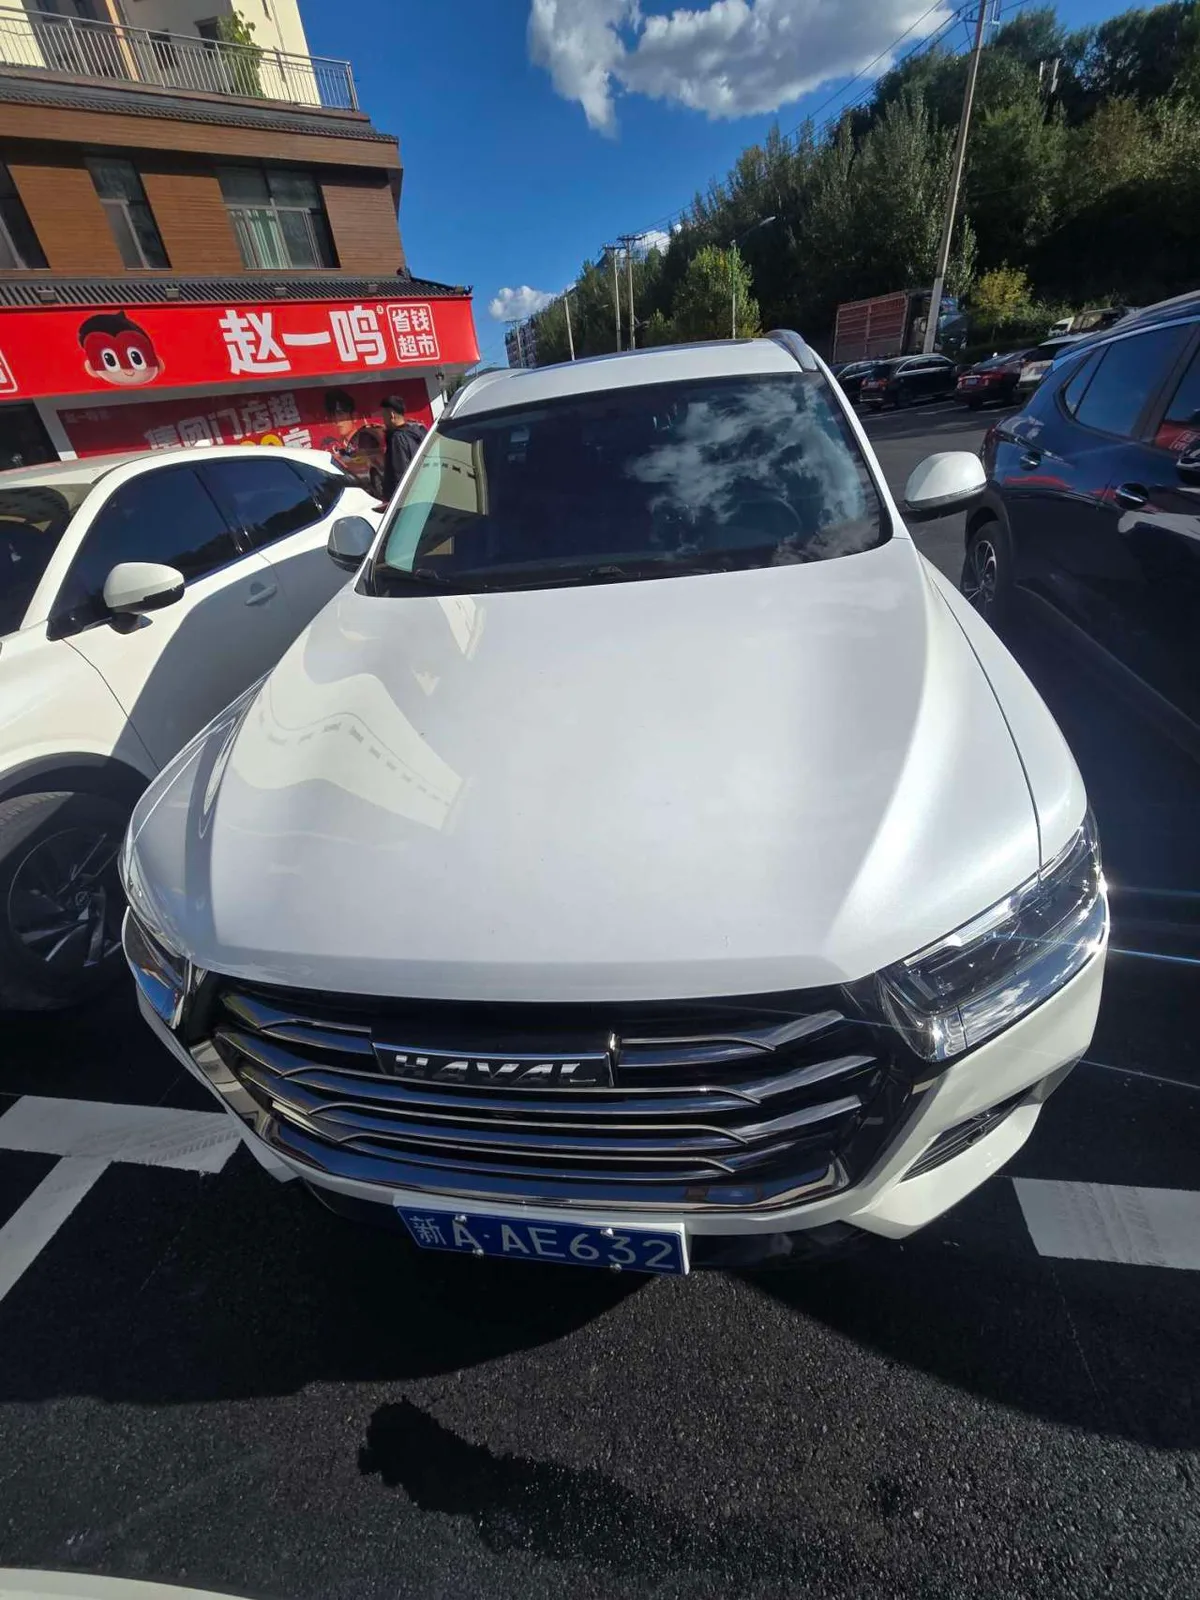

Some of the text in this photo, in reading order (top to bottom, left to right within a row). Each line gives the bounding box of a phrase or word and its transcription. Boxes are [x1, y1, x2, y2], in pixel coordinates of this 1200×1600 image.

[392, 308, 430, 332] 省钱
[219, 305, 387, 375] 赵一鸣
[398, 333, 435, 357] 超市
[394, 1054, 597, 1082] HAVAL
